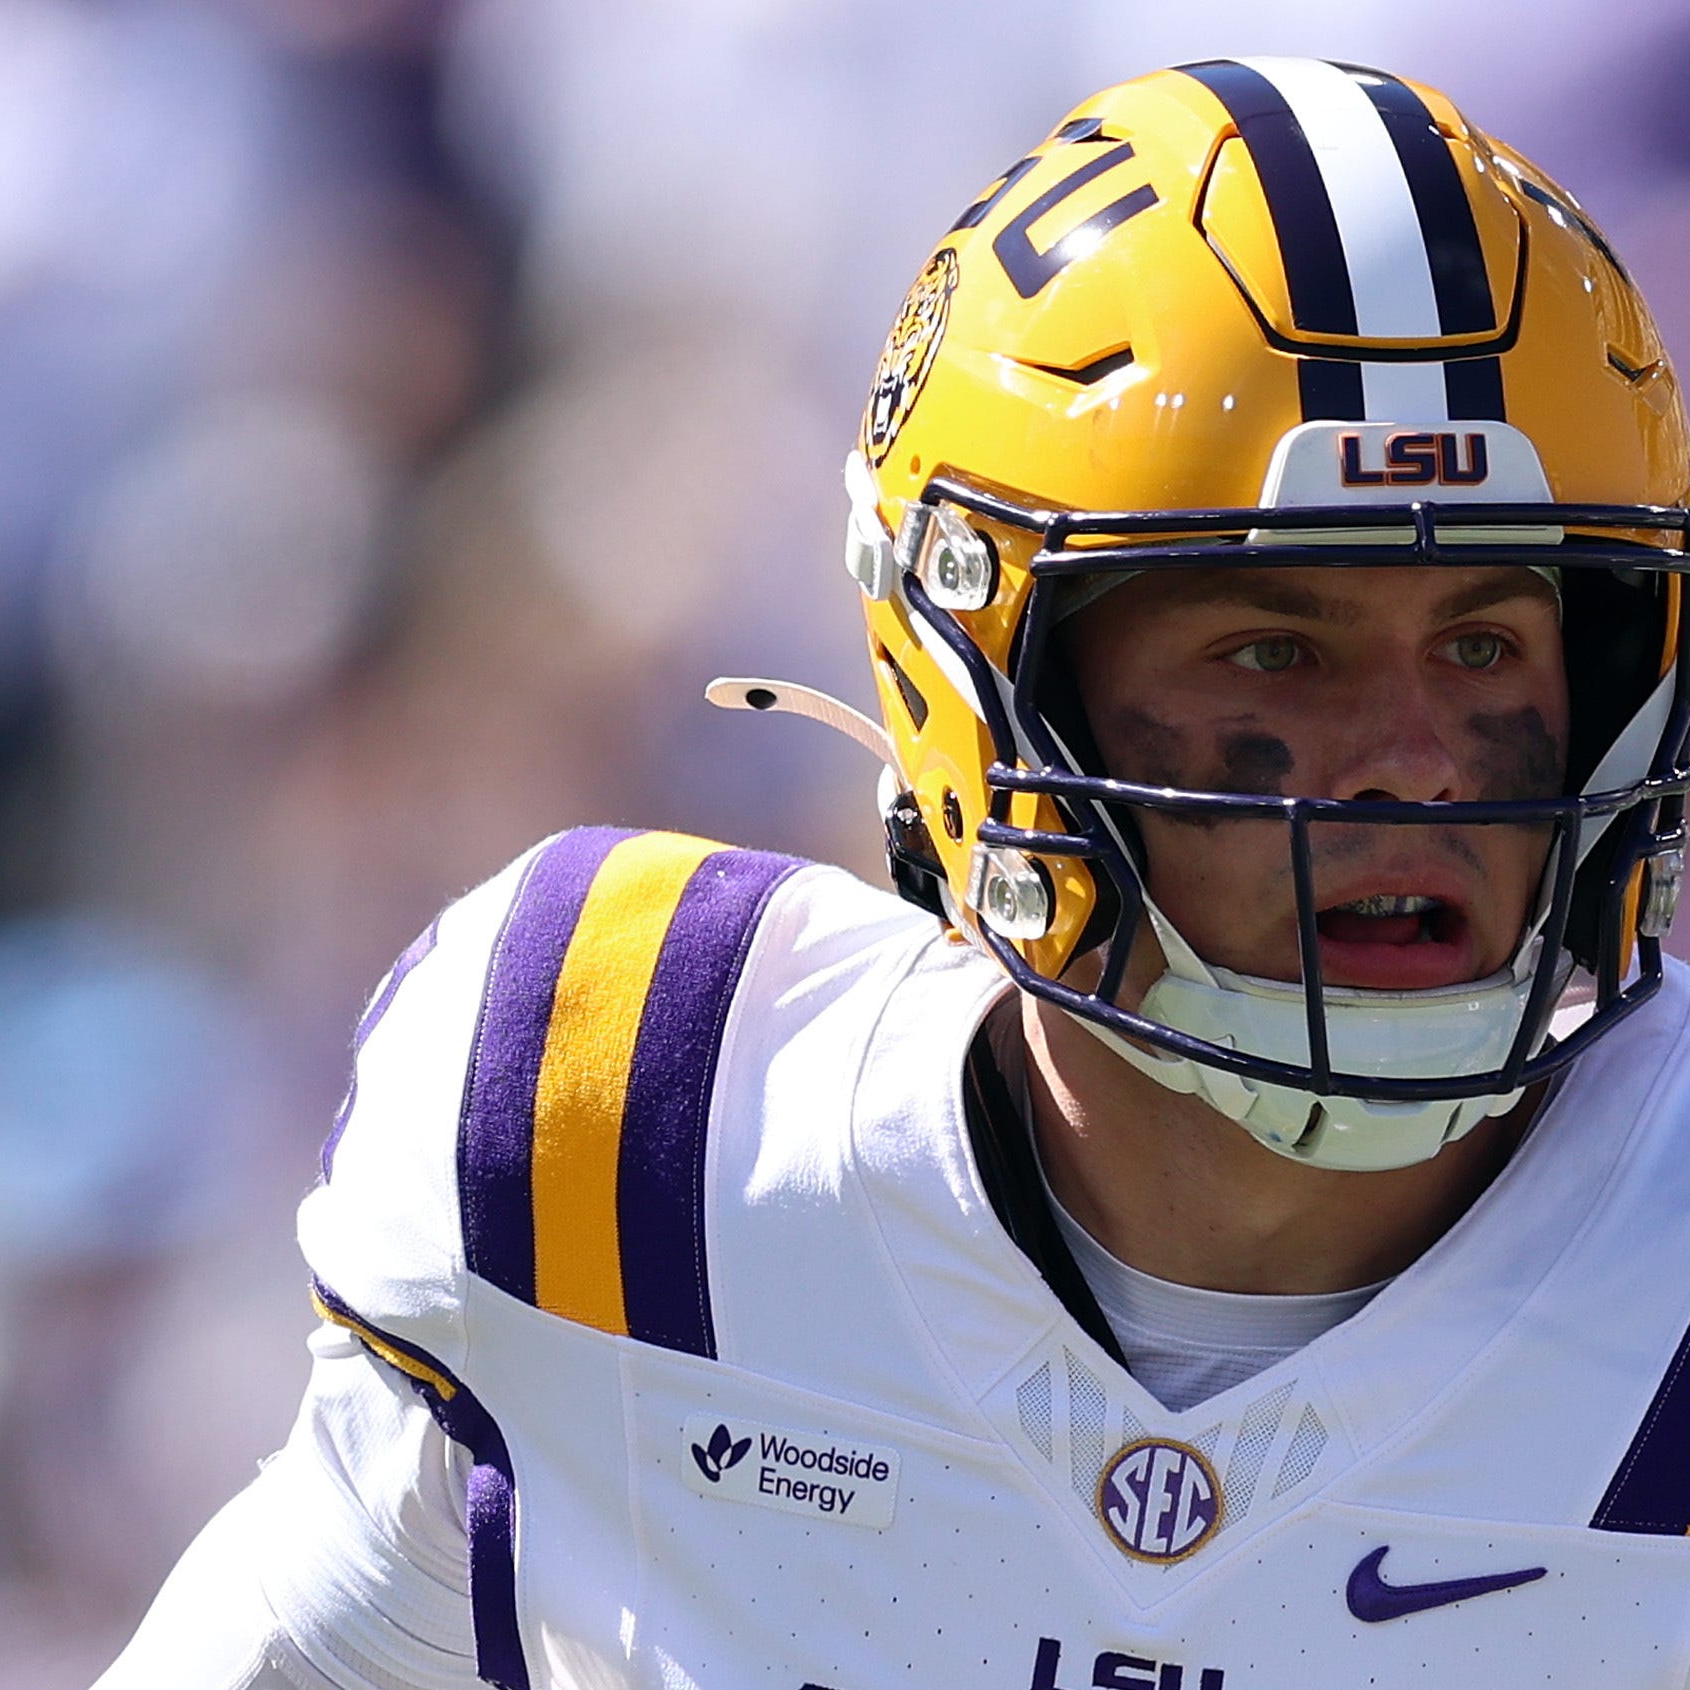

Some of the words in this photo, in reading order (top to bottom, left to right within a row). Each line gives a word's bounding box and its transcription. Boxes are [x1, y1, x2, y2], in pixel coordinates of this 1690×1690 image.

[1338, 431, 1489, 487] LSU
[760, 1431, 890, 1482] Woodside
[758, 1465, 856, 1514] Energy
[1108, 1446, 1211, 1554] SEC
